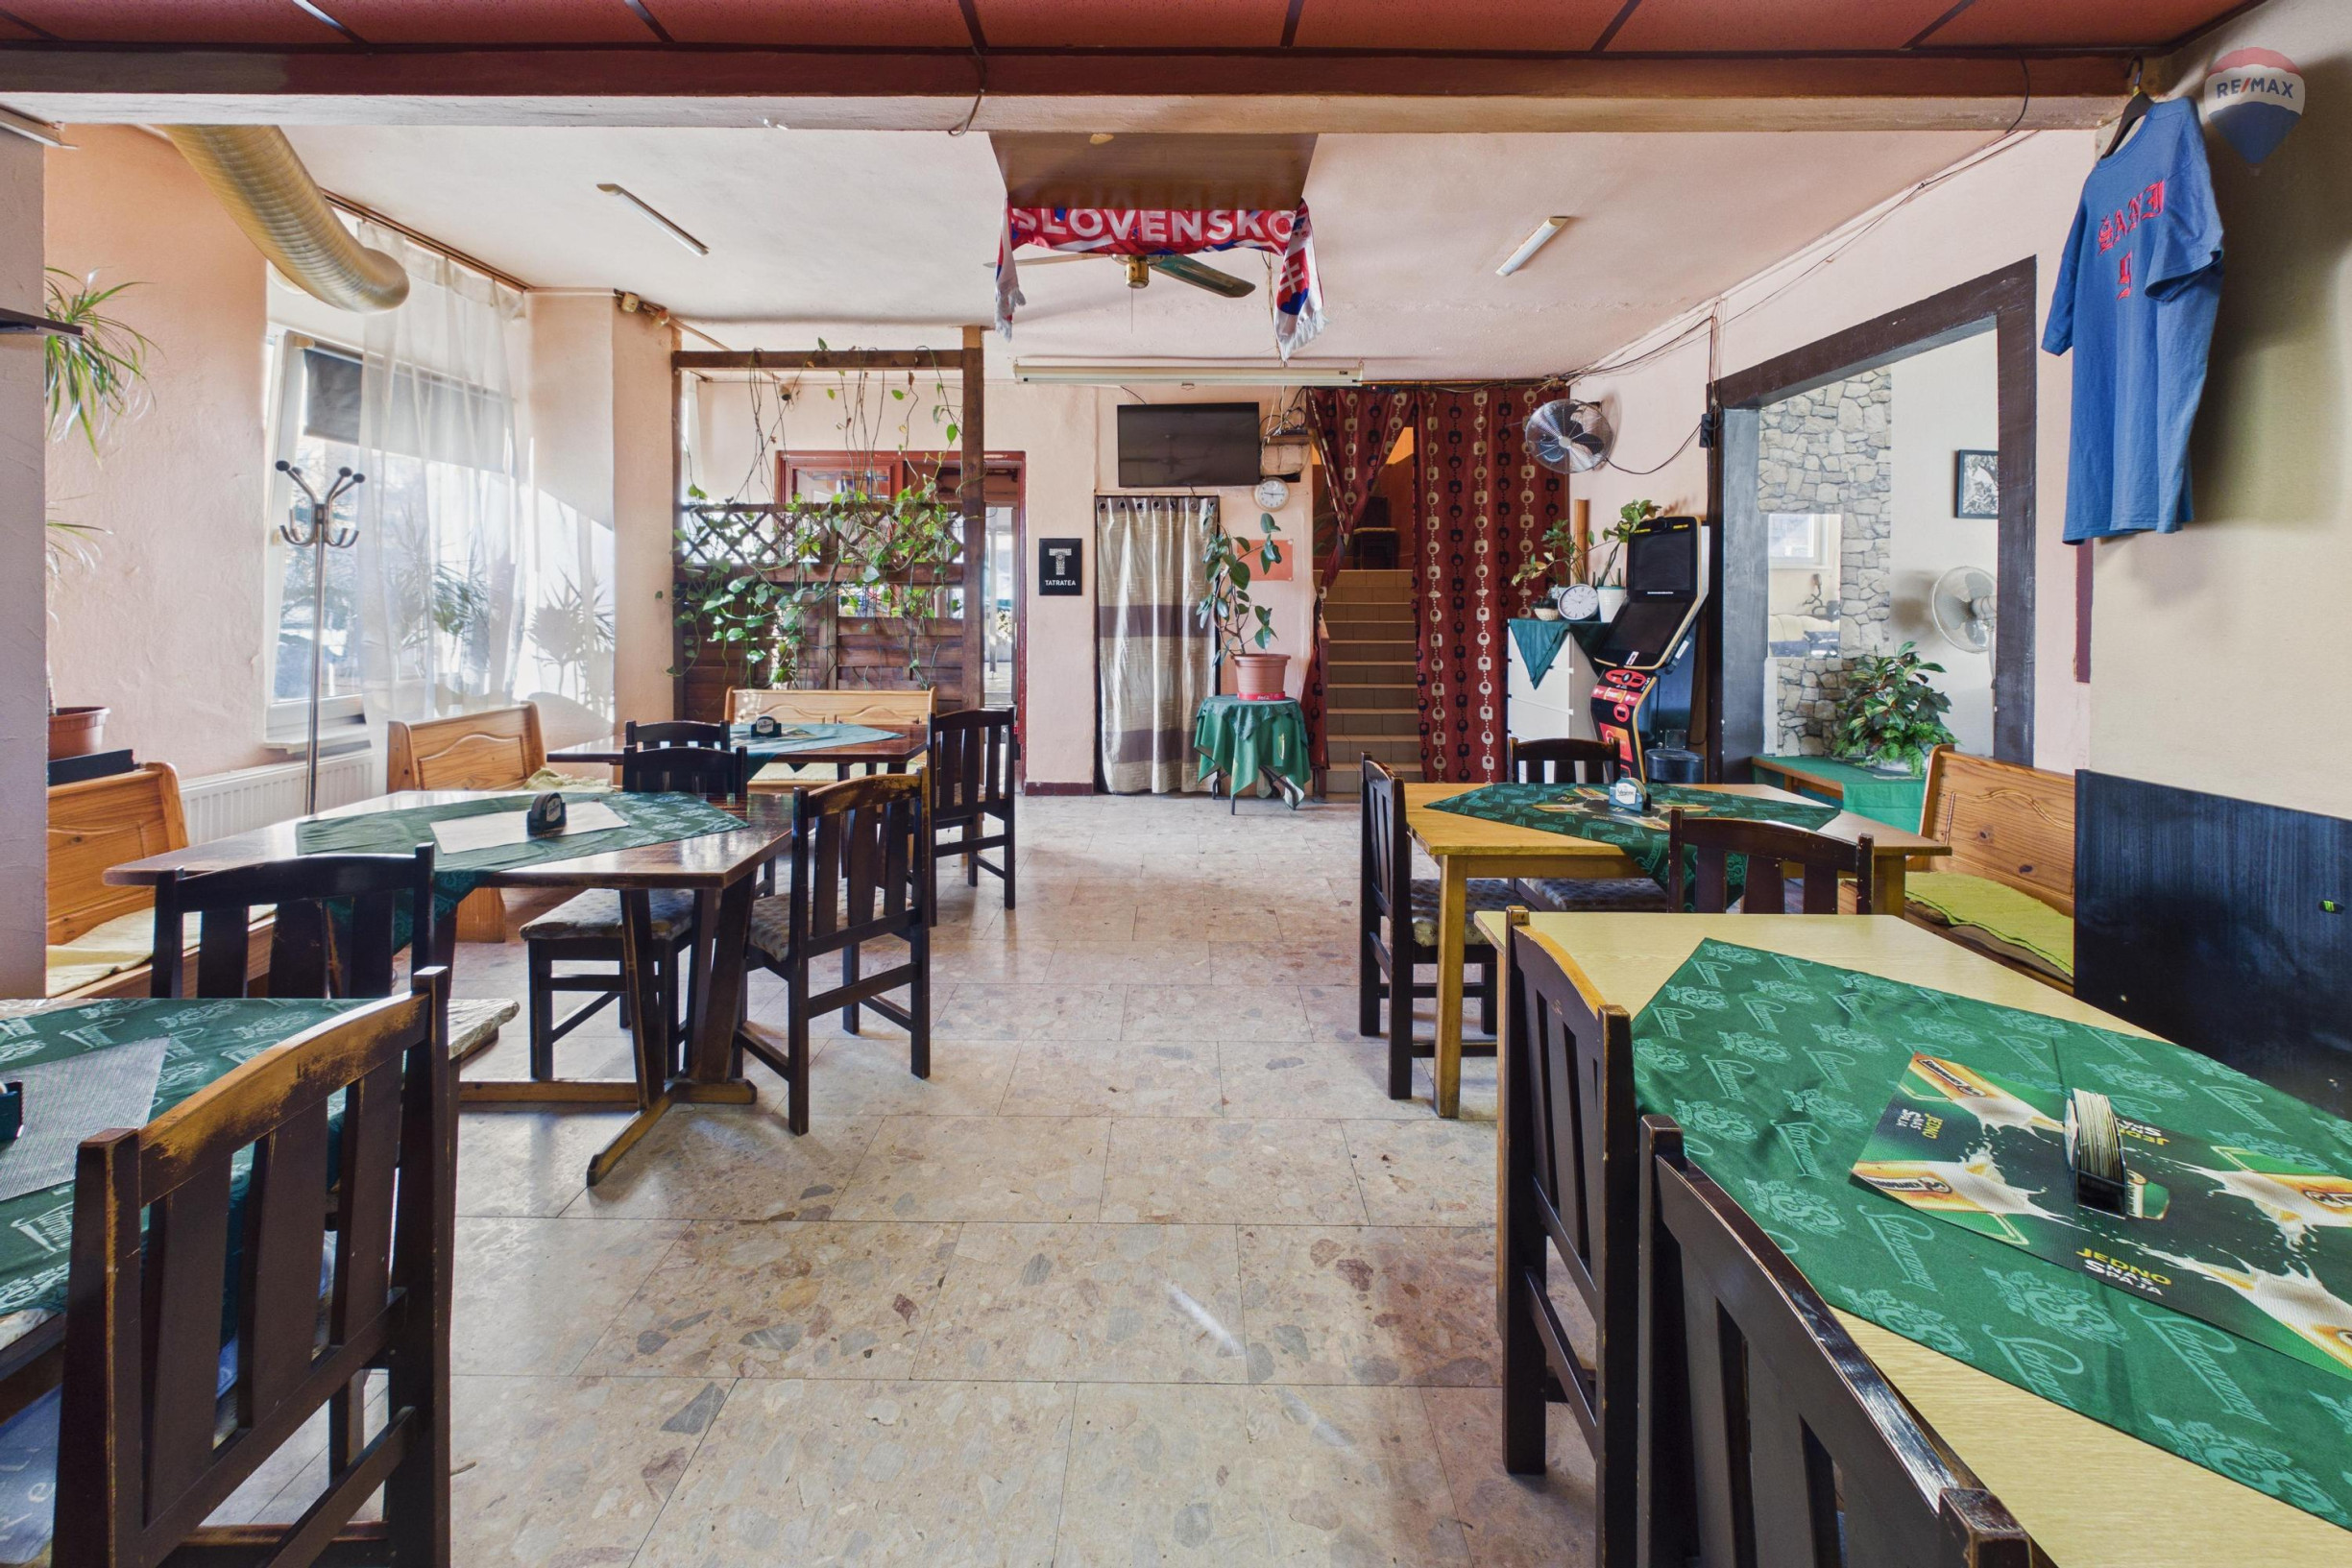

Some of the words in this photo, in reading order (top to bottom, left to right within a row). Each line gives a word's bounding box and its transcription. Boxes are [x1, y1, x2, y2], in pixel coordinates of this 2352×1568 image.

[1011, 207, 1297, 243] SLOVENSKO
[1856, 1204, 1943, 1297] Staropramen
[2075, 1247, 2172, 1286] JEDNO
[2127, 1302, 2283, 1432] Staropramen
